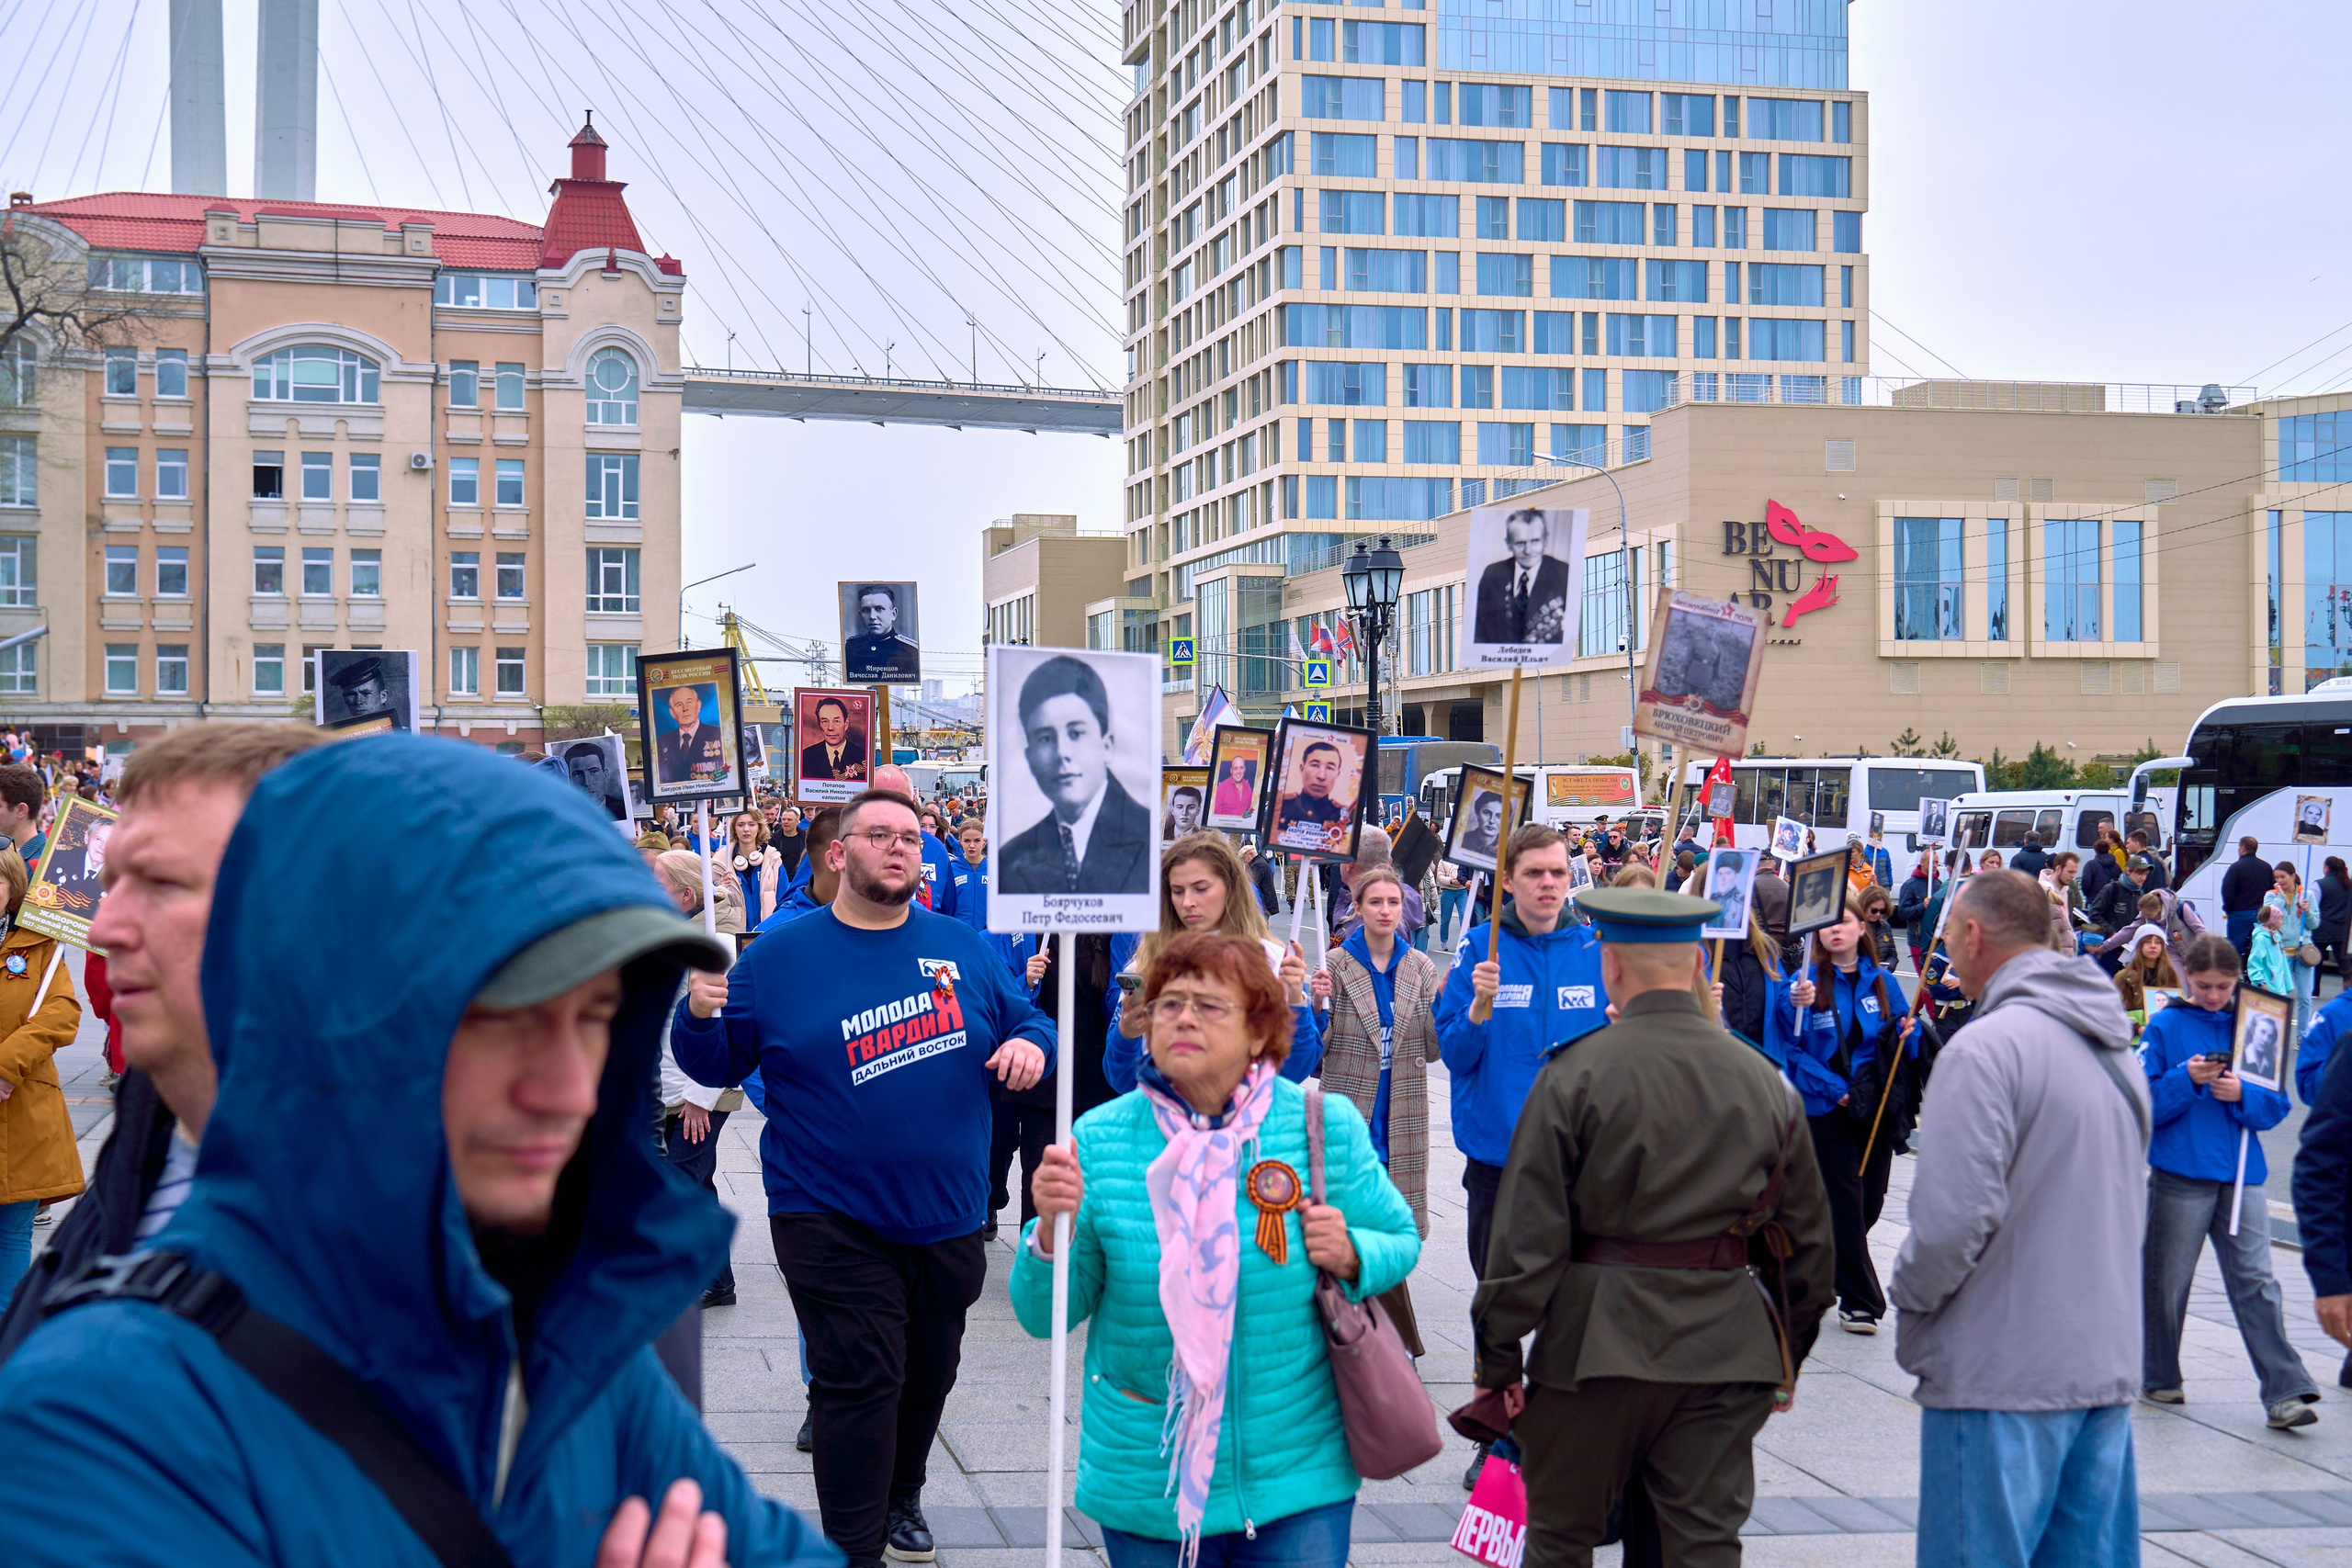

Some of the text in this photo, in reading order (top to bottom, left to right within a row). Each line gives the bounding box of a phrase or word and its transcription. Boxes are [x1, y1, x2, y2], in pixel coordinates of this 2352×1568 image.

[1722, 521, 1773, 556] BE
[1748, 558, 1804, 592] NU
[1498, 646, 1532, 654] Лебедев
[671, 664, 712, 675] БЕССМЕРТНЫЙ
[341, 725, 382, 739] ССМЕРТНЫЙ
[1652, 708, 1731, 735] БРЮХОВЕЦКИЙ
[1653, 720, 1682, 732] АНДРЕЙ
[1683, 728, 1724, 743] ПЕТРОВИЧ
[661, 785, 683, 794] Бакуров
[1043, 895, 1103, 910] Боярчуков
[23, 911, 88, 940] Николай Васил
[39, 908, 91, 932] ЖАВОРОНК
[1023, 910, 1124, 926] Петр Федосеевич
[1495, 987, 1533, 1001] ВАРДИЯ
[1498, 984, 1533, 1000] ОЛОДАЯ
[842, 989, 964, 1042] МОЛОДАЯ
[846, 992, 965, 1067] ГВАРДИЯ
[855, 1034, 966, 1084] ДАЛЬНИЙ ВОСТОК
[1451, 1503, 1527, 1568] ПЕРВЫ
